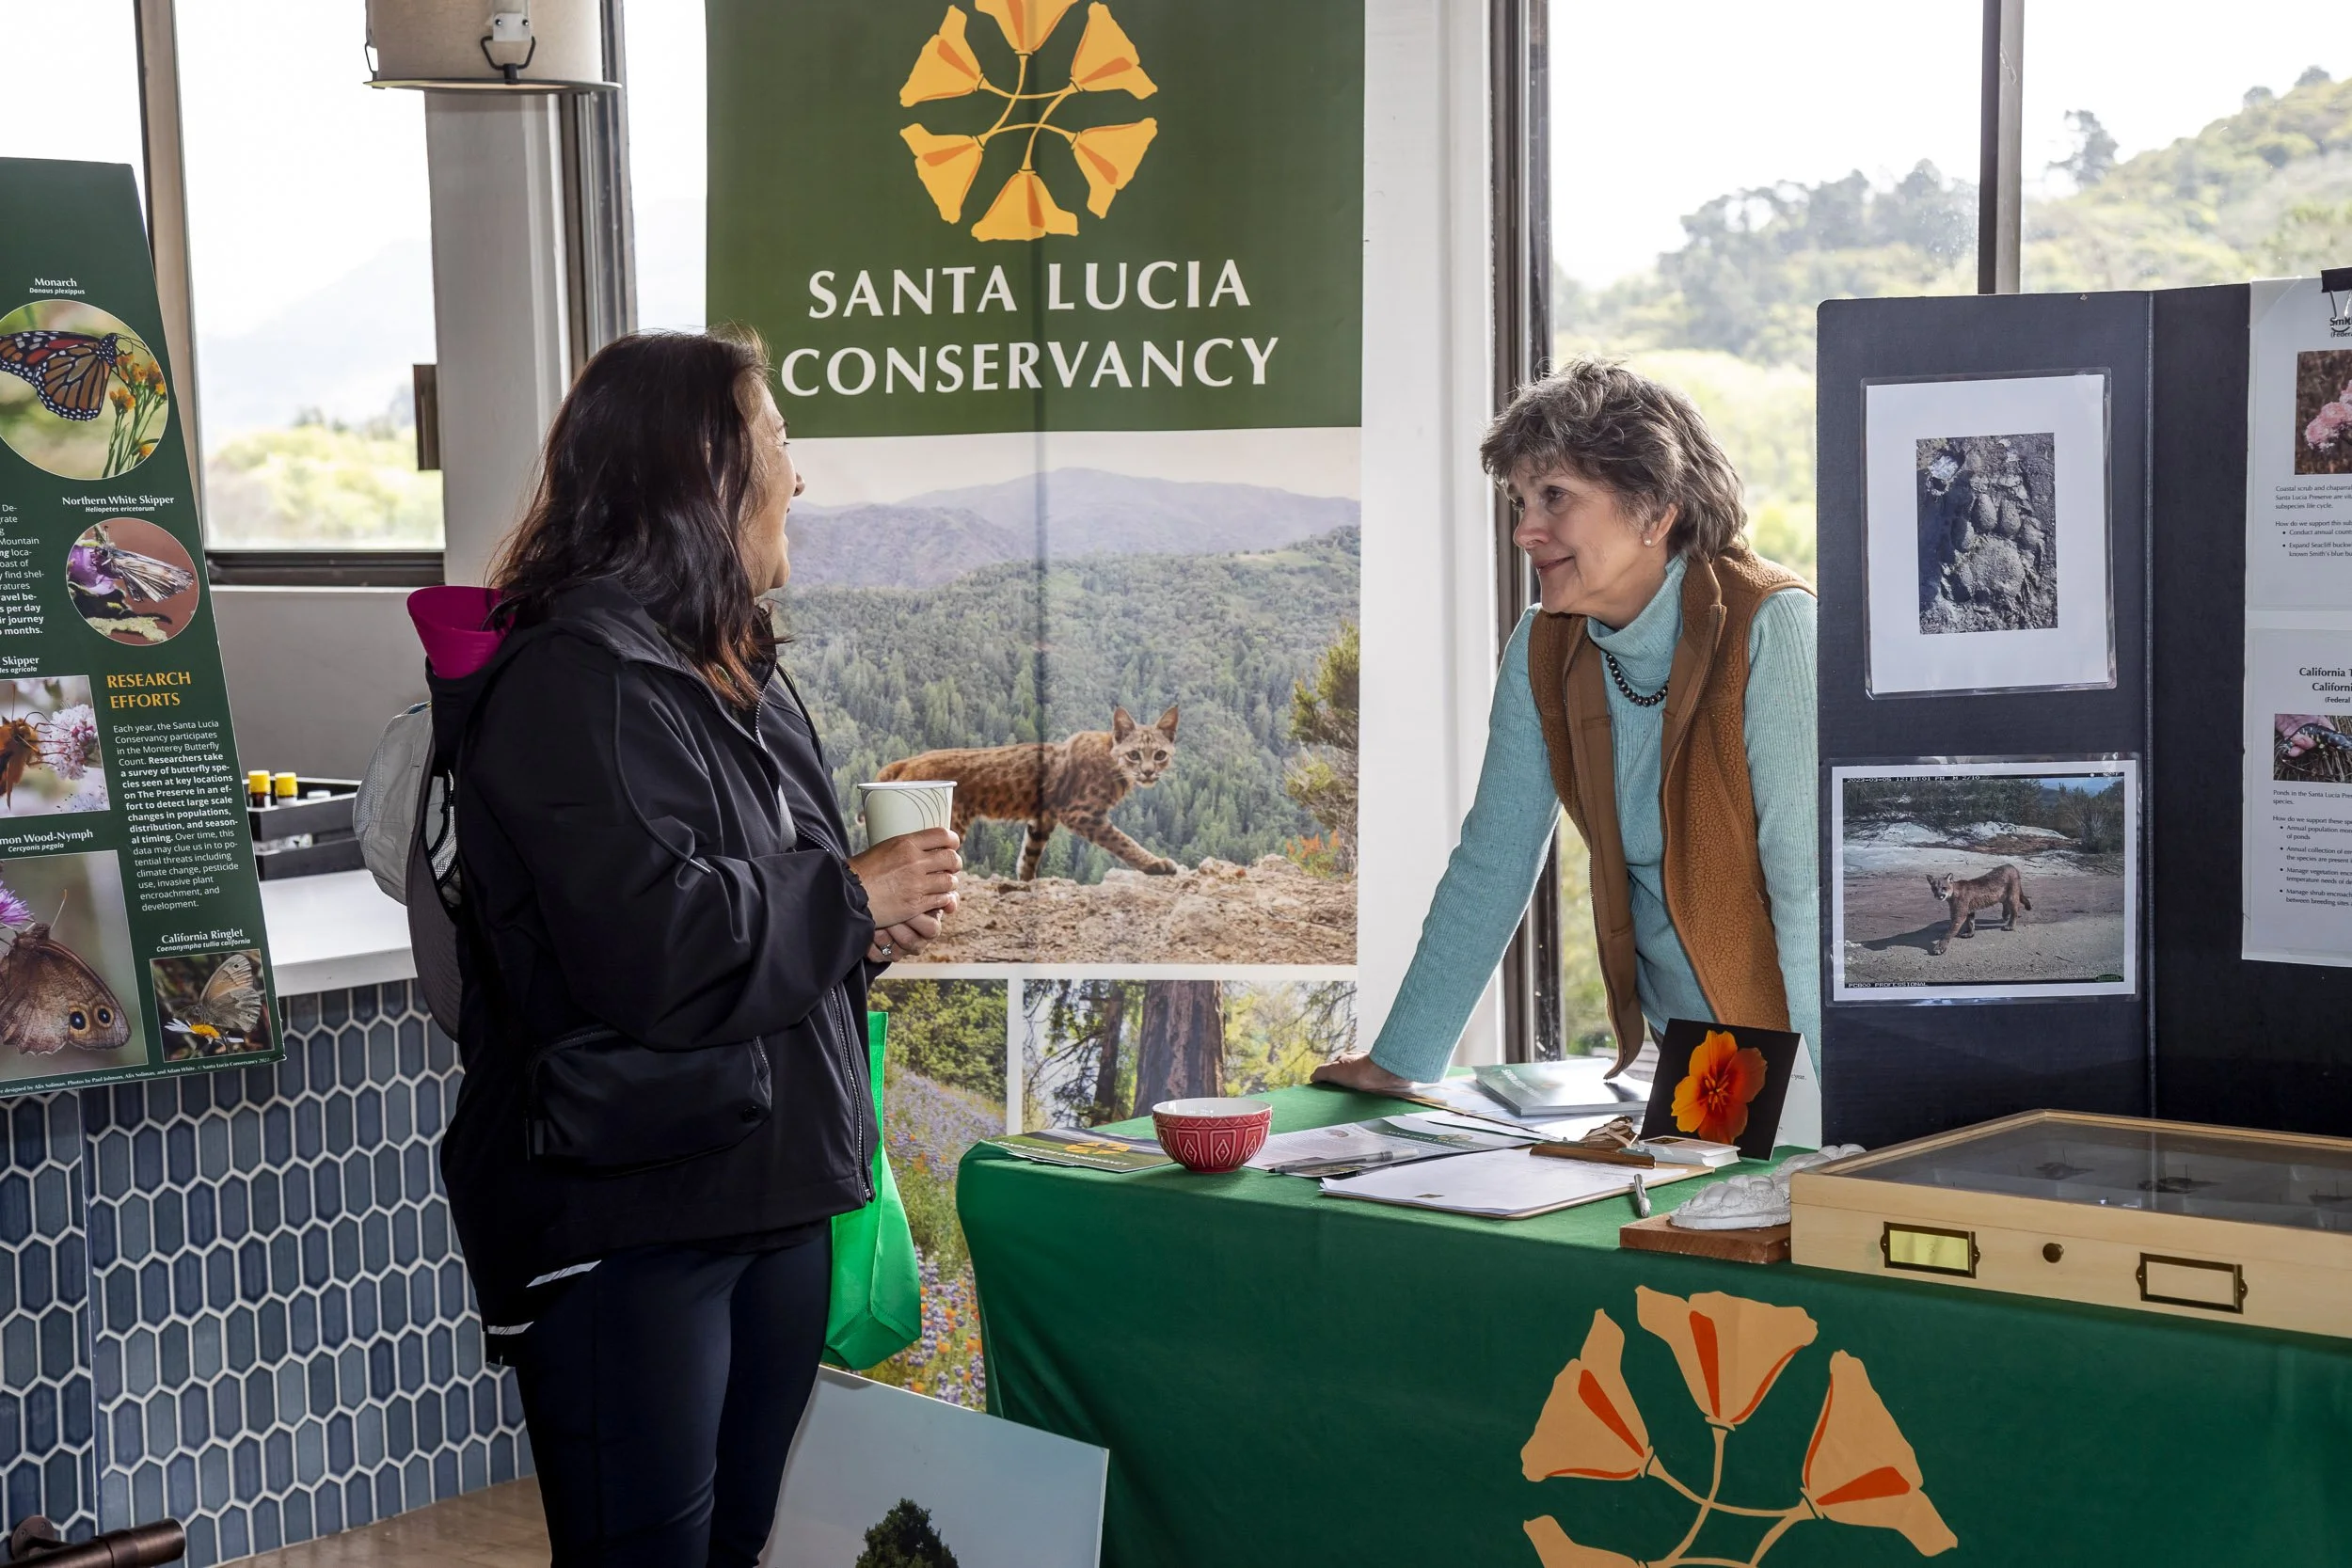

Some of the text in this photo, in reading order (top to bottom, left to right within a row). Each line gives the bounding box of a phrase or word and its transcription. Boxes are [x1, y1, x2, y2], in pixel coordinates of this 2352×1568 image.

[34, 277, 77, 287] Monarch
[808, 259, 1251, 319] SANTA LUCIA
[781, 337, 1279, 398] CONSERVANCY
[62, 496, 174, 507] Northern White Skipper
[20, 559, 29, 567] of
[24, 570, 44, 578] shel-
[7, 606, 22, 614] per
[24, 604, 40, 612] day
[8, 616, 44, 626] journey
[5, 626, 43, 635] months.
[2, 656, 40, 667] Skipper
[2299, 667, 2345, 676] California
[106, 672, 192, 688] RESEARCH
[110, 692, 181, 709] EFFORTS
[114, 720, 219, 734] Each year, the Santa Lucia
[115, 732, 217, 744] Conservancy participates
[127, 746, 140, 754] the
[143, 744, 183, 754] Monterey
[184, 742, 219, 752] Butterfly
[119, 752, 224, 767] Count. Researchers take
[128, 768, 158, 778] survey
[160, 766, 169, 774] of
[171, 764, 210, 774] butterfly
[212, 765, 230, 774] spe-
[176, 777, 192, 787] key
[194, 774, 233, 784] locations
[137, 790, 154, 799] The
[156, 787, 195, 797] Preserve
[197, 786, 205, 795] in
[220, 784, 231, 793] ef-
[126, 797, 233, 811] fort to detect large scale
[128, 813, 164, 823] changes
[178, 808, 231, 821] populations,
[129, 821, 184, 833] distribution,
[187, 820, 203, 829] and
[24, 829, 93, 843] Wood-Nymph
[132, 836, 139, 845] al
[142, 833, 174, 845] timing.
[175, 832, 196, 841] Over
[197, 831, 217, 840] time,
[133, 847, 152, 856] data
[154, 847, 171, 856] may
[173, 844, 191, 852] clue
[225, 841, 238, 850] po-
[135, 852, 231, 866] tential threats including
[136, 863, 239, 878] climate change, pesticide
[157, 878, 191, 887] invasive
[193, 876, 214, 886] plant
[140, 886, 220, 900] encroachment, and
[142, 900, 199, 911] development.
[161, 928, 244, 944] California Ringlet
